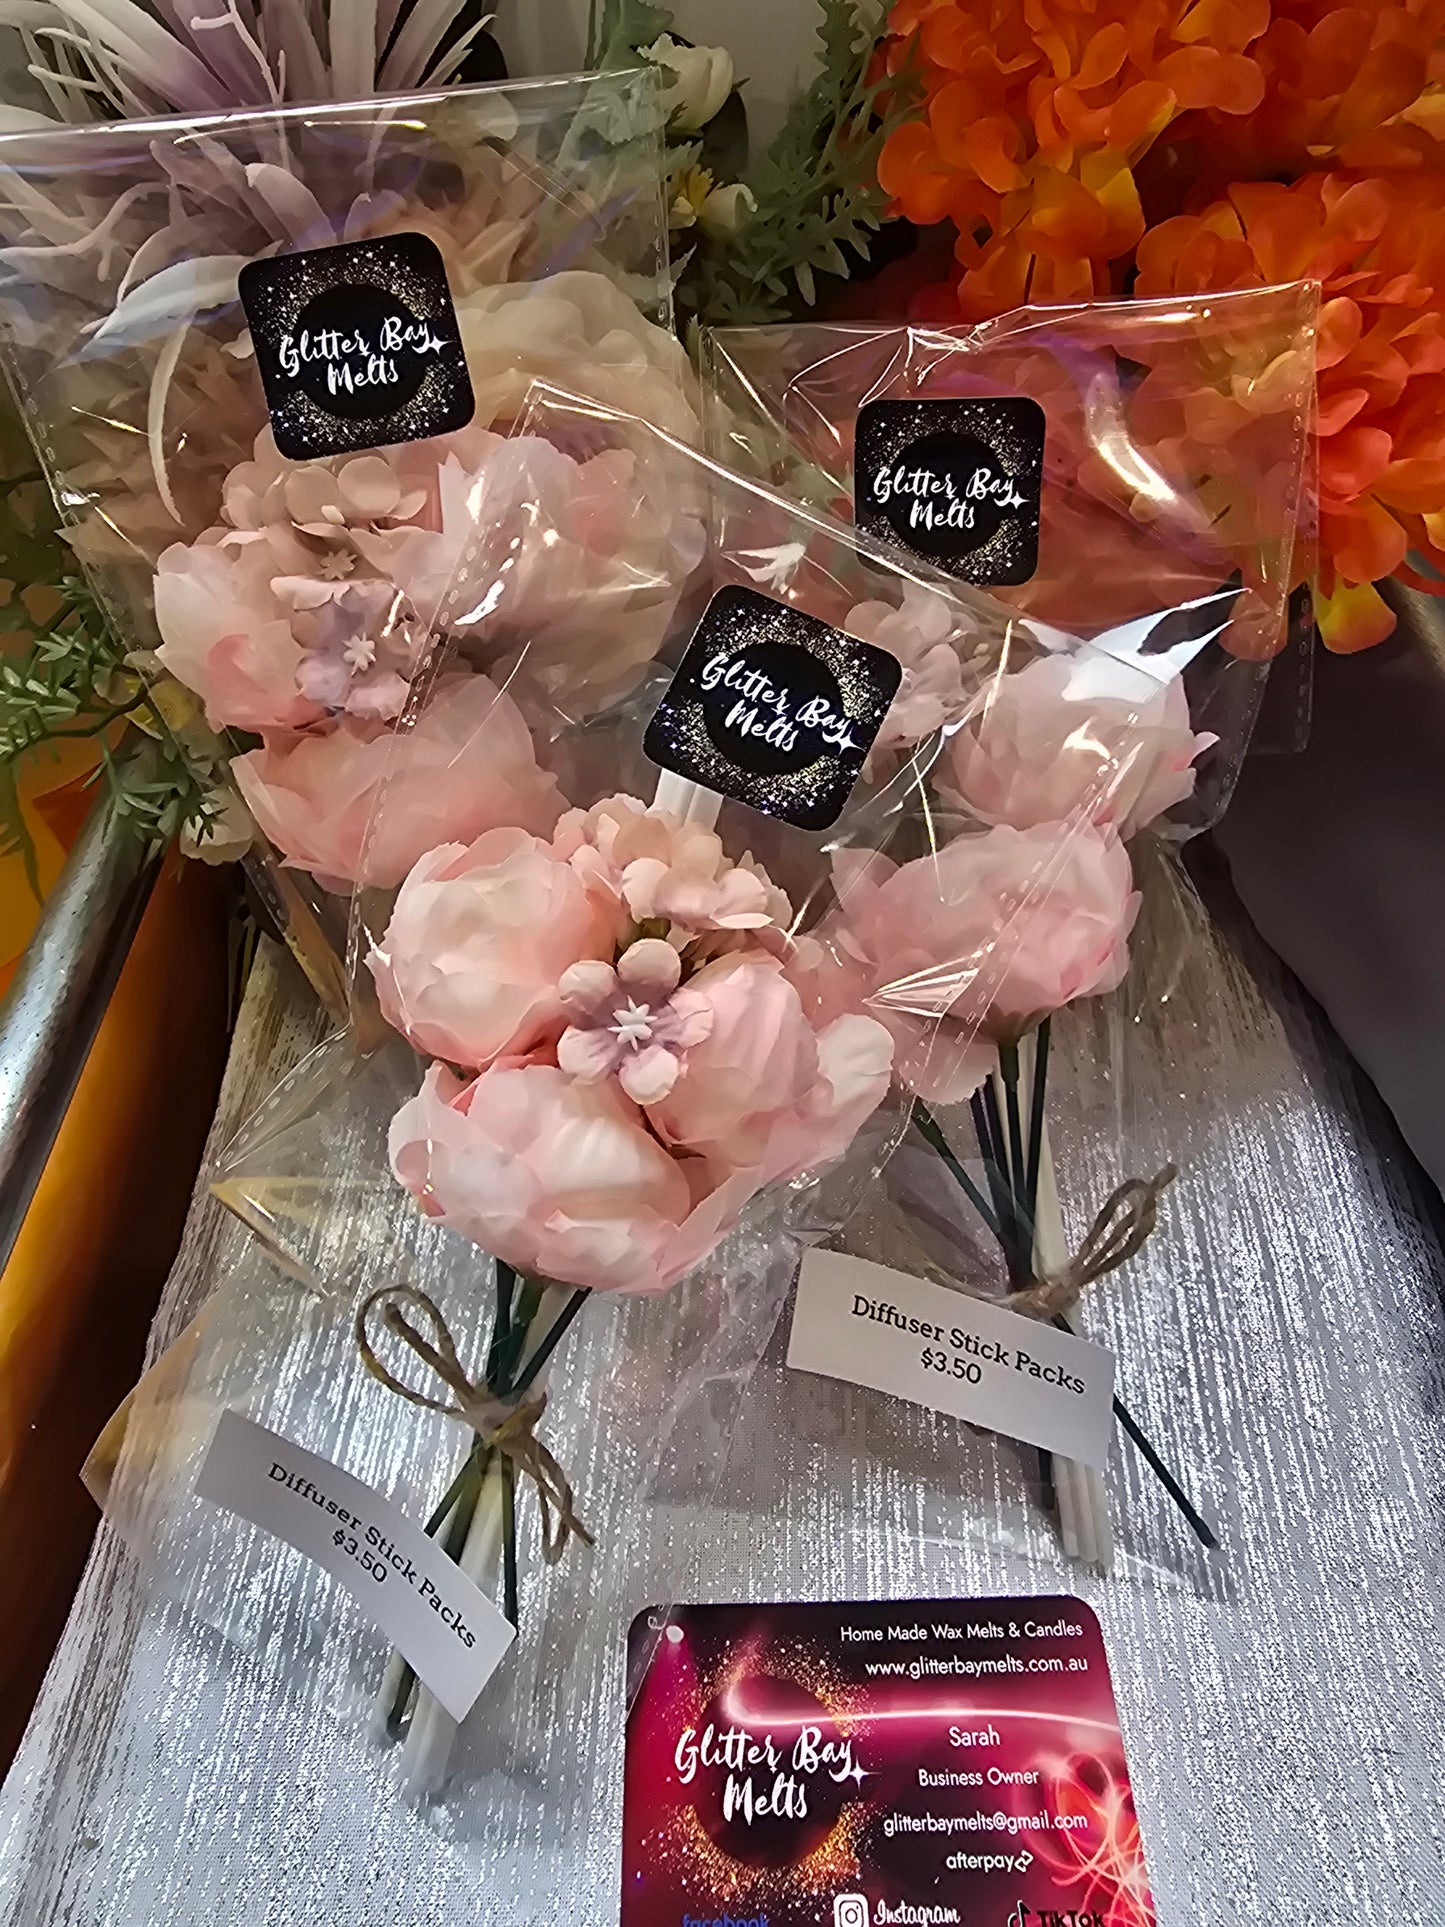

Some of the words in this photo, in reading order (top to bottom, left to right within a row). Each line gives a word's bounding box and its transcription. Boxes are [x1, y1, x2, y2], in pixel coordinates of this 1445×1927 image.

[279, 329, 370, 377] Glitter
[379, 316, 433, 354] Bay
[326, 354, 399, 395] Melts
[873, 465, 958, 504] Glitter
[965, 468, 1015, 507] Bay
[909, 499, 975, 531] Melts
[701, 655, 790, 711] Glitter
[795, 697, 852, 744] Bay
[725, 699, 799, 752] Melts
[851, 1295, 944, 1342] Diffuser
[949, 1328, 1009, 1367] Stick
[1014, 1349, 1085, 1395] Packs
[920, 1347, 982, 1385] $3.50
[267, 1462, 362, 1530] Diffuser
[364, 1525, 418, 1585] Stick
[417, 1577, 477, 1650] Packs
[331, 1529, 388, 1584] $3.50
[840, 1626, 884, 1643] Home
[887, 1624, 928, 1641] Made
[930, 1623, 963, 1640] Wax
[966, 1621, 1004, 1640] Melts
[1008, 1622, 1021, 1638] &
[1024, 1619, 1084, 1638] Candles
[865, 1653, 1089, 1679] www.glitterbaymelts.com.au
[674, 1723, 783, 1784] Glitter
[791, 1724, 853, 1782] Bay
[948, 1724, 1001, 1747] Sarah
[918, 1768, 984, 1787] Business
[986, 1767, 1039, 1785] Owner
[722, 1772, 808, 1826] Melts
[883, 1809, 1088, 1837] glitterbaymelts@gmail.com
[945, 1851, 1015, 1873] afterpay
[873, 1898, 961, 1925] Instagram
[1037, 1909, 1107, 1927] TikTok
